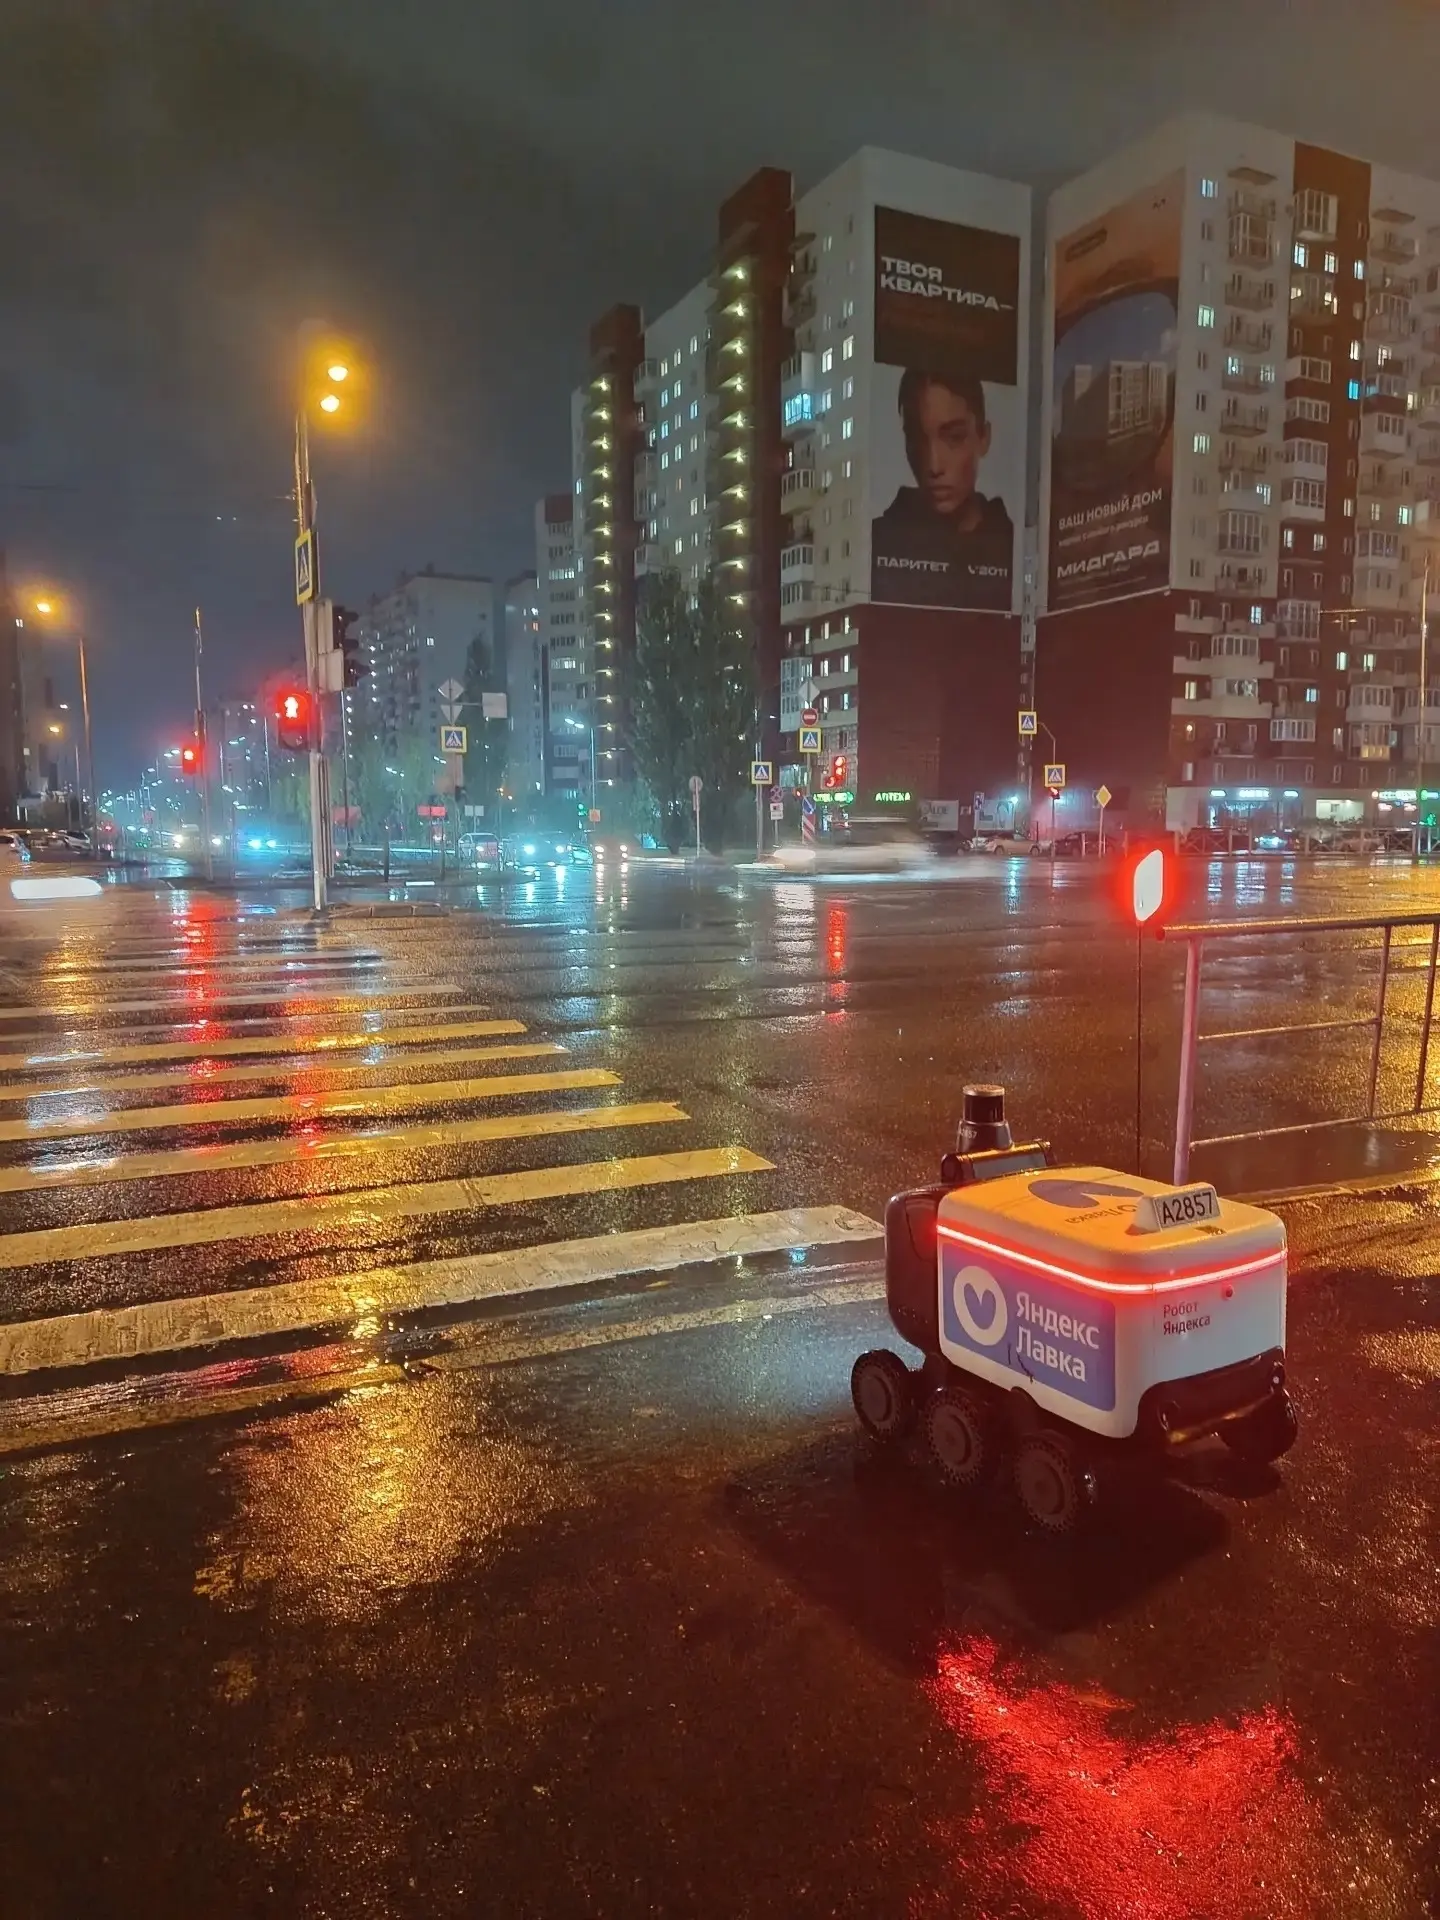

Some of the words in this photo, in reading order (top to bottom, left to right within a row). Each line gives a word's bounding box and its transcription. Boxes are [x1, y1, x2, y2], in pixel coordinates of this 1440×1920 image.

[881, 256, 942, 282] ТВОЯ
[1059, 511, 1084, 530] ВАШ
[1087, 494, 1130, 522] НОВЫЙ
[1131, 488, 1162, 511] ДОМ
[877, 556, 949, 573] ПАРИТЕТ
[1057, 540, 1159, 578] МИДГАРД
[1162, 1192, 1212, 1225] A2857
[1016, 1291, 1099, 1350] Яндекс
[1163, 1301, 1198, 1318] Робот
[1163, 1315, 1211, 1336] Яндекса
[1016, 1325, 1086, 1382] Лавка
